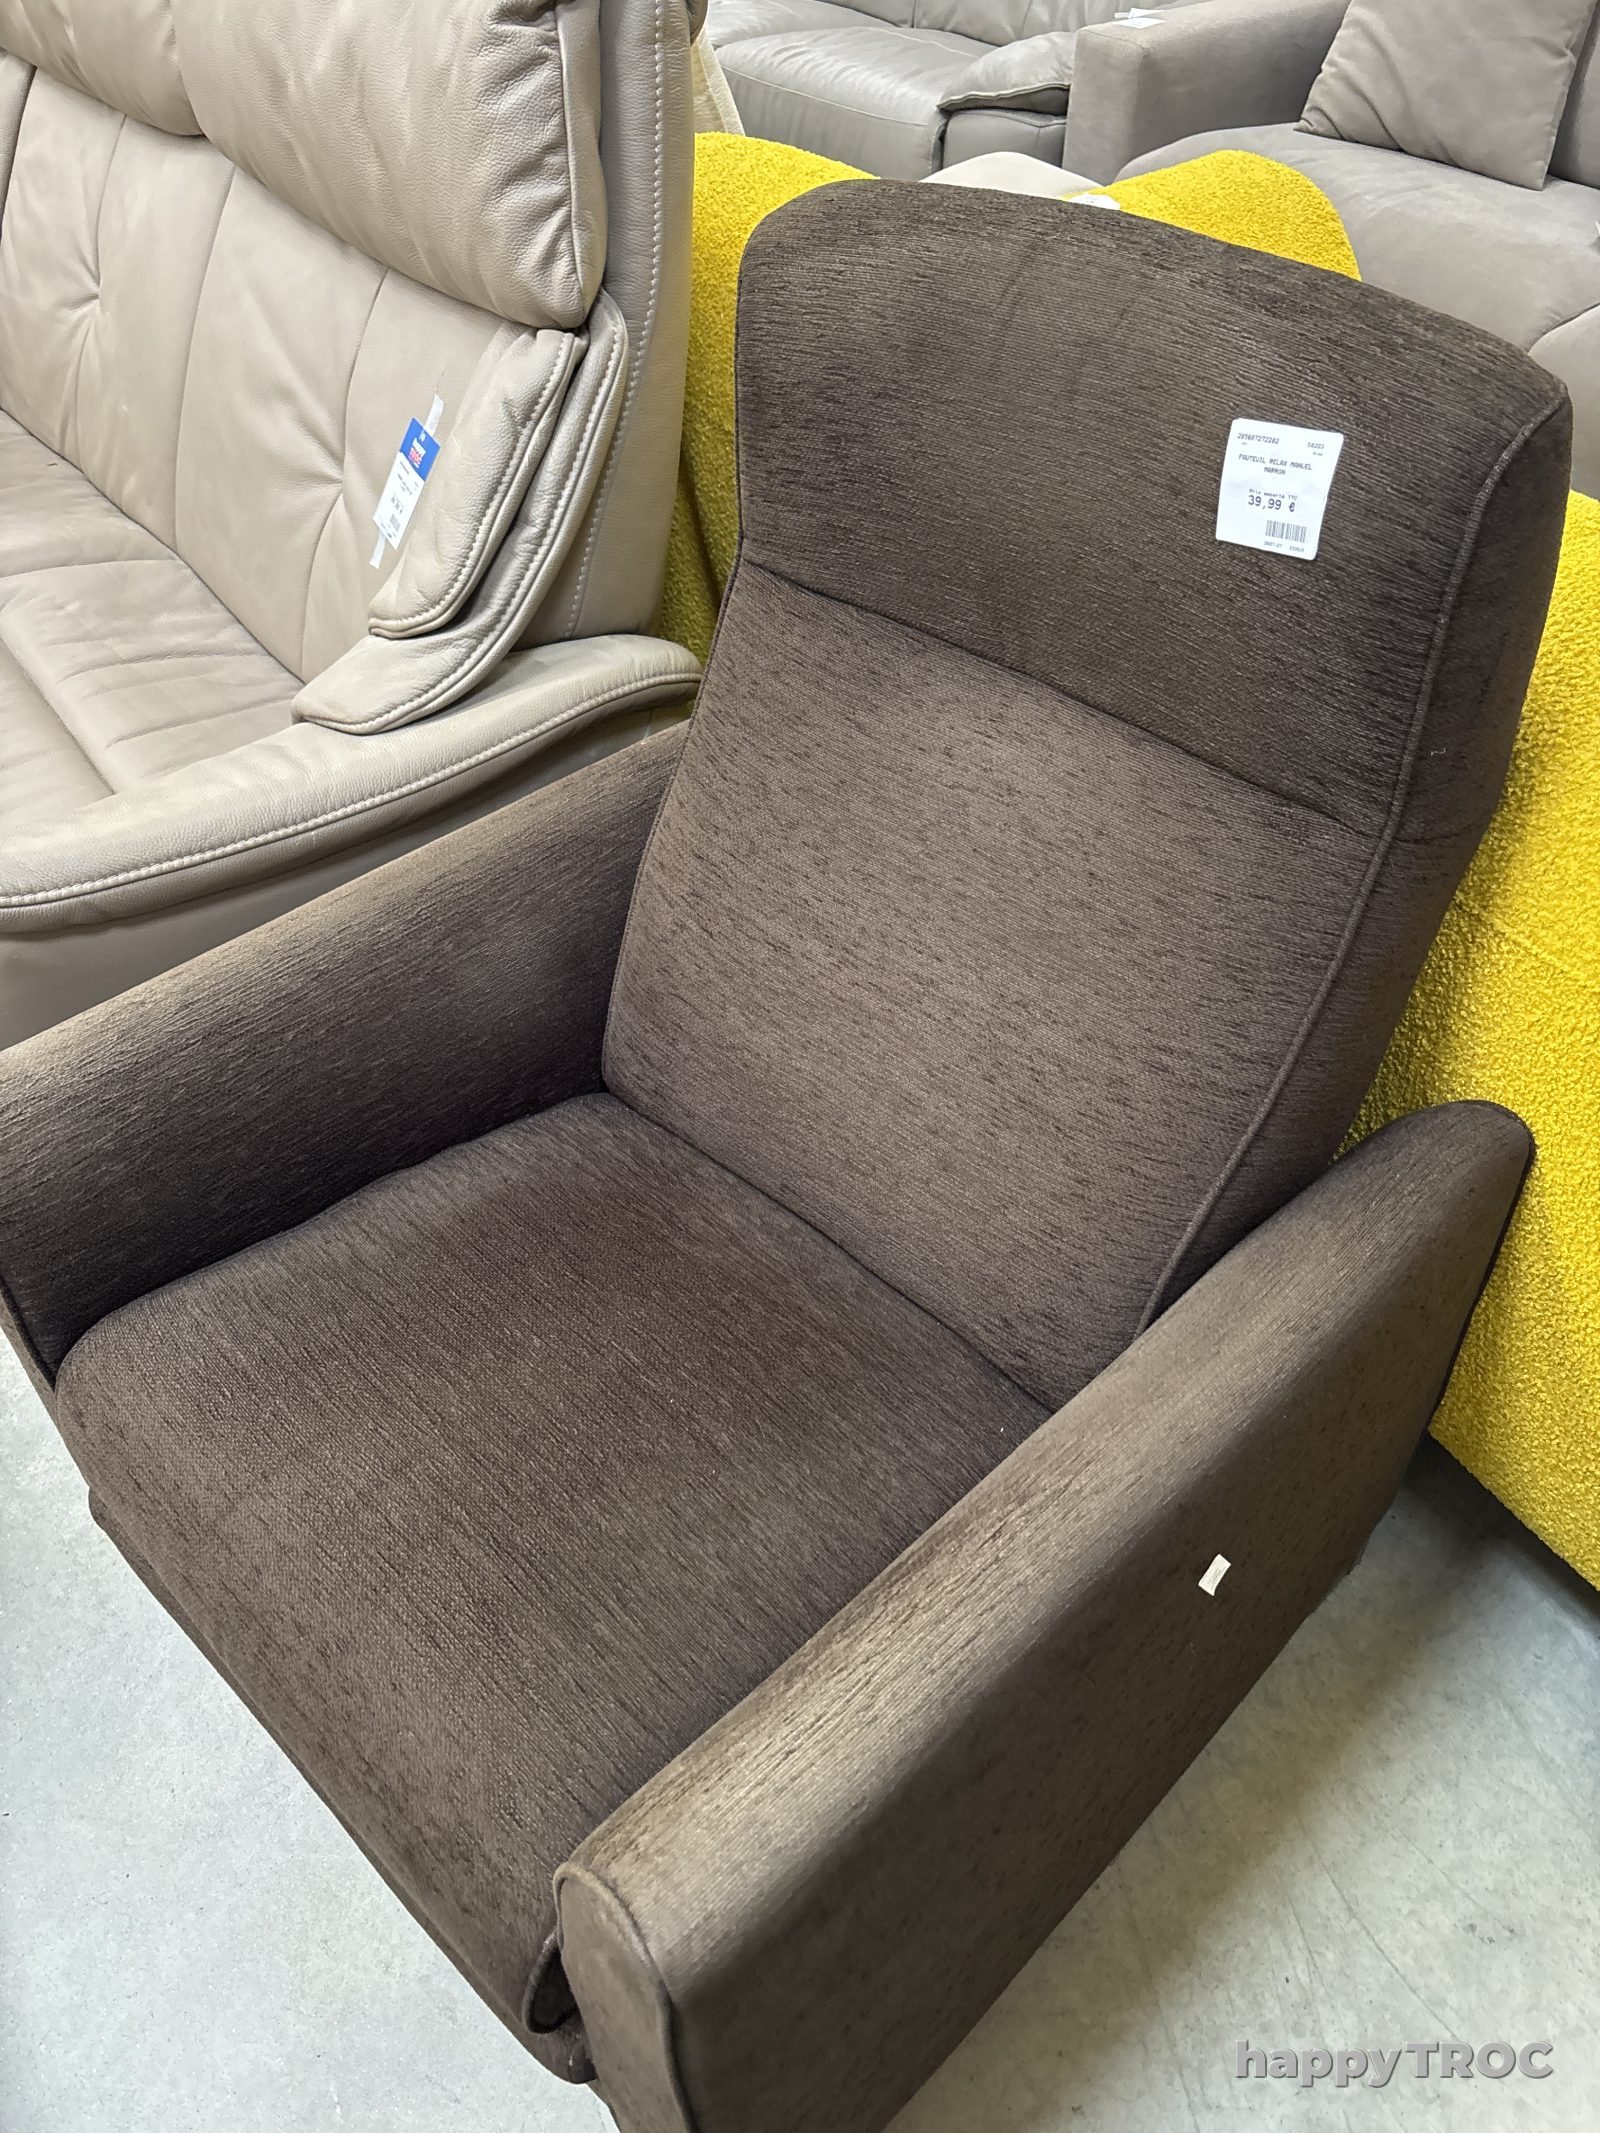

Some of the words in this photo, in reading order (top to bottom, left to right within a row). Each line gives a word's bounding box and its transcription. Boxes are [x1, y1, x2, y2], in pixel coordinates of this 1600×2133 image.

[1238, 453, 1266, 464] FAUTEUIL
[1269, 458, 1287, 467] RELAX
[1263, 466, 1286, 476] MARRON
[1247, 494, 1282, 510] 39,99
[1288, 501, 1297, 513] €
